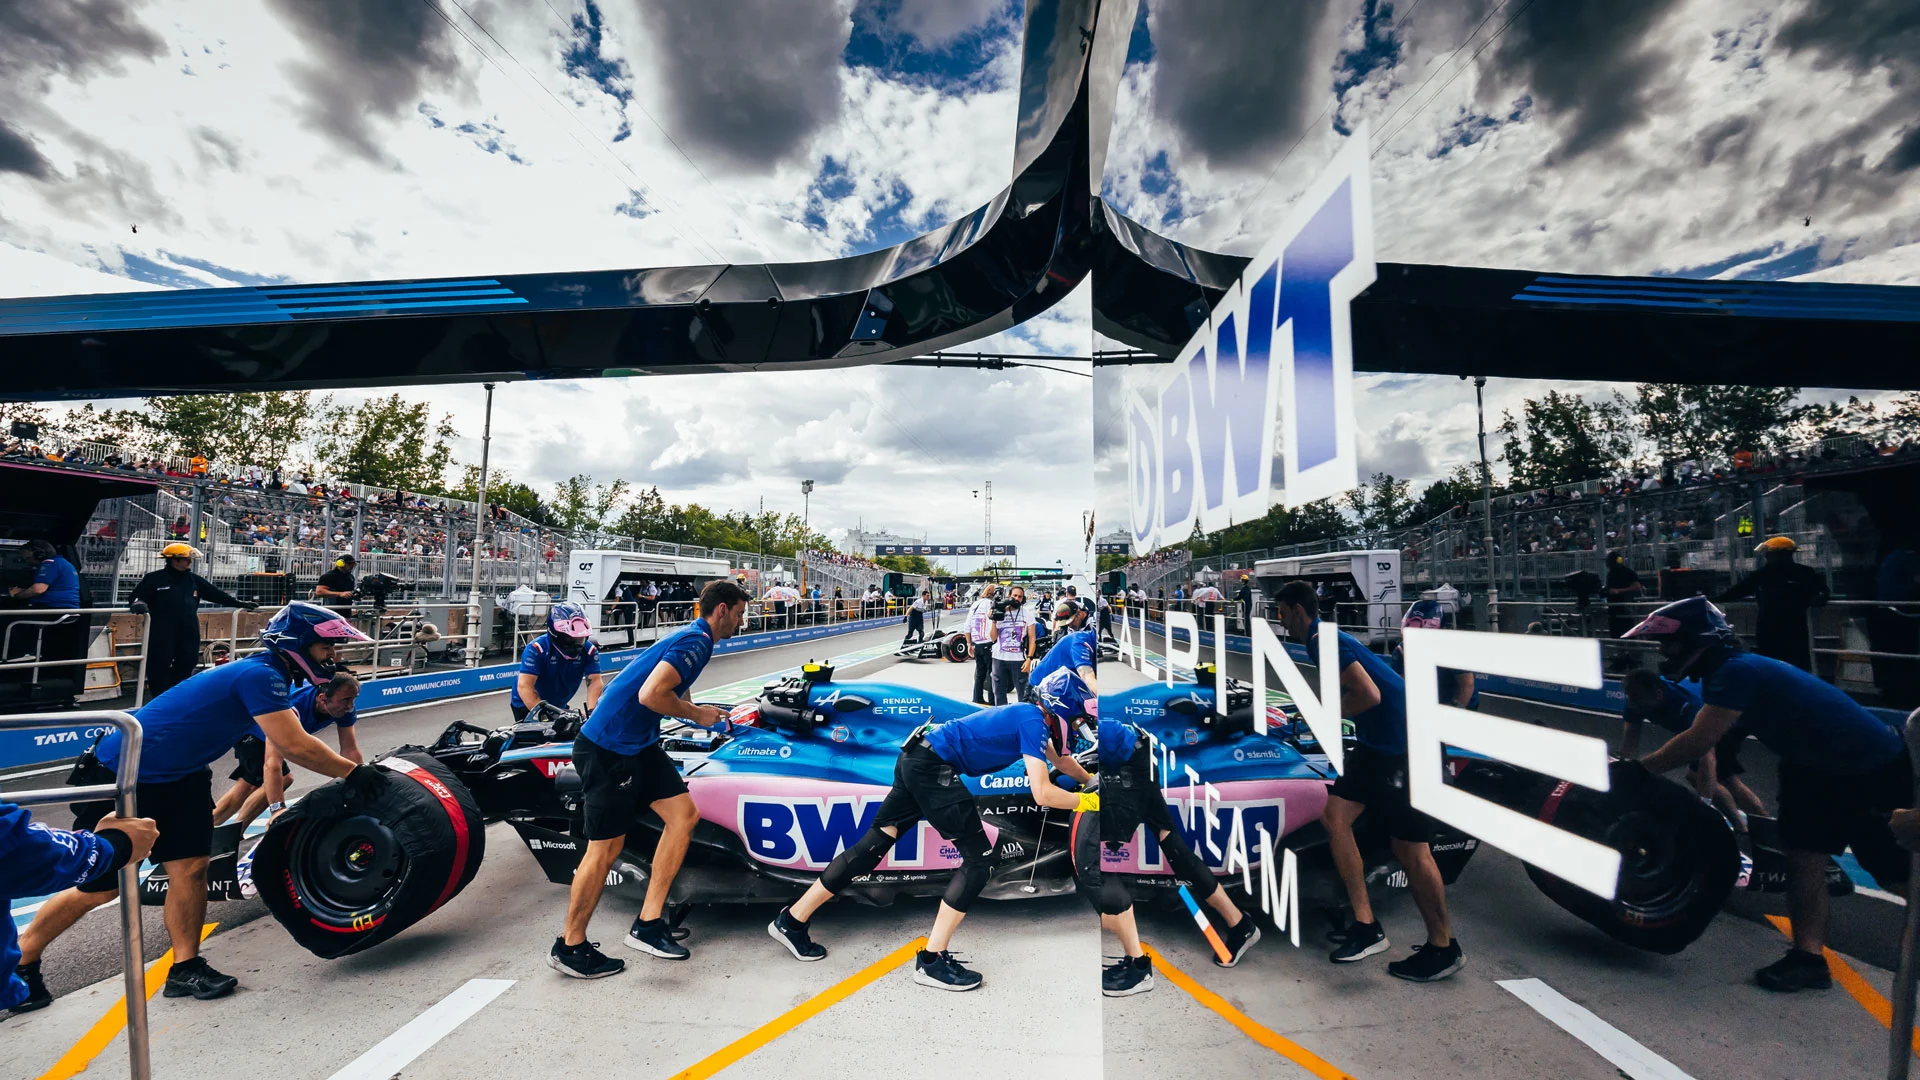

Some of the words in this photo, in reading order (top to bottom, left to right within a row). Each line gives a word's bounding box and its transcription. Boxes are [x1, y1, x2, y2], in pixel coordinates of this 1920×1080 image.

[1162, 174, 1355, 528] BWT
[479, 674, 494, 682] TATA
[382, 687, 403, 696] TATA
[404, 677, 461, 692] COMMUNICATIONS
[882, 697, 922, 705] RENAULT
[872, 705, 932, 715] E-TECH
[34, 731, 79, 746] TATA
[738, 748, 777, 756] ultimate
[1118, 605, 1622, 900] ALPINE
[983, 805, 1050, 816] ALPINE
[542, 840, 577, 850] Microsoft
[1001, 841, 1024, 855] ADA
[1185, 763, 1300, 949] TEAM
